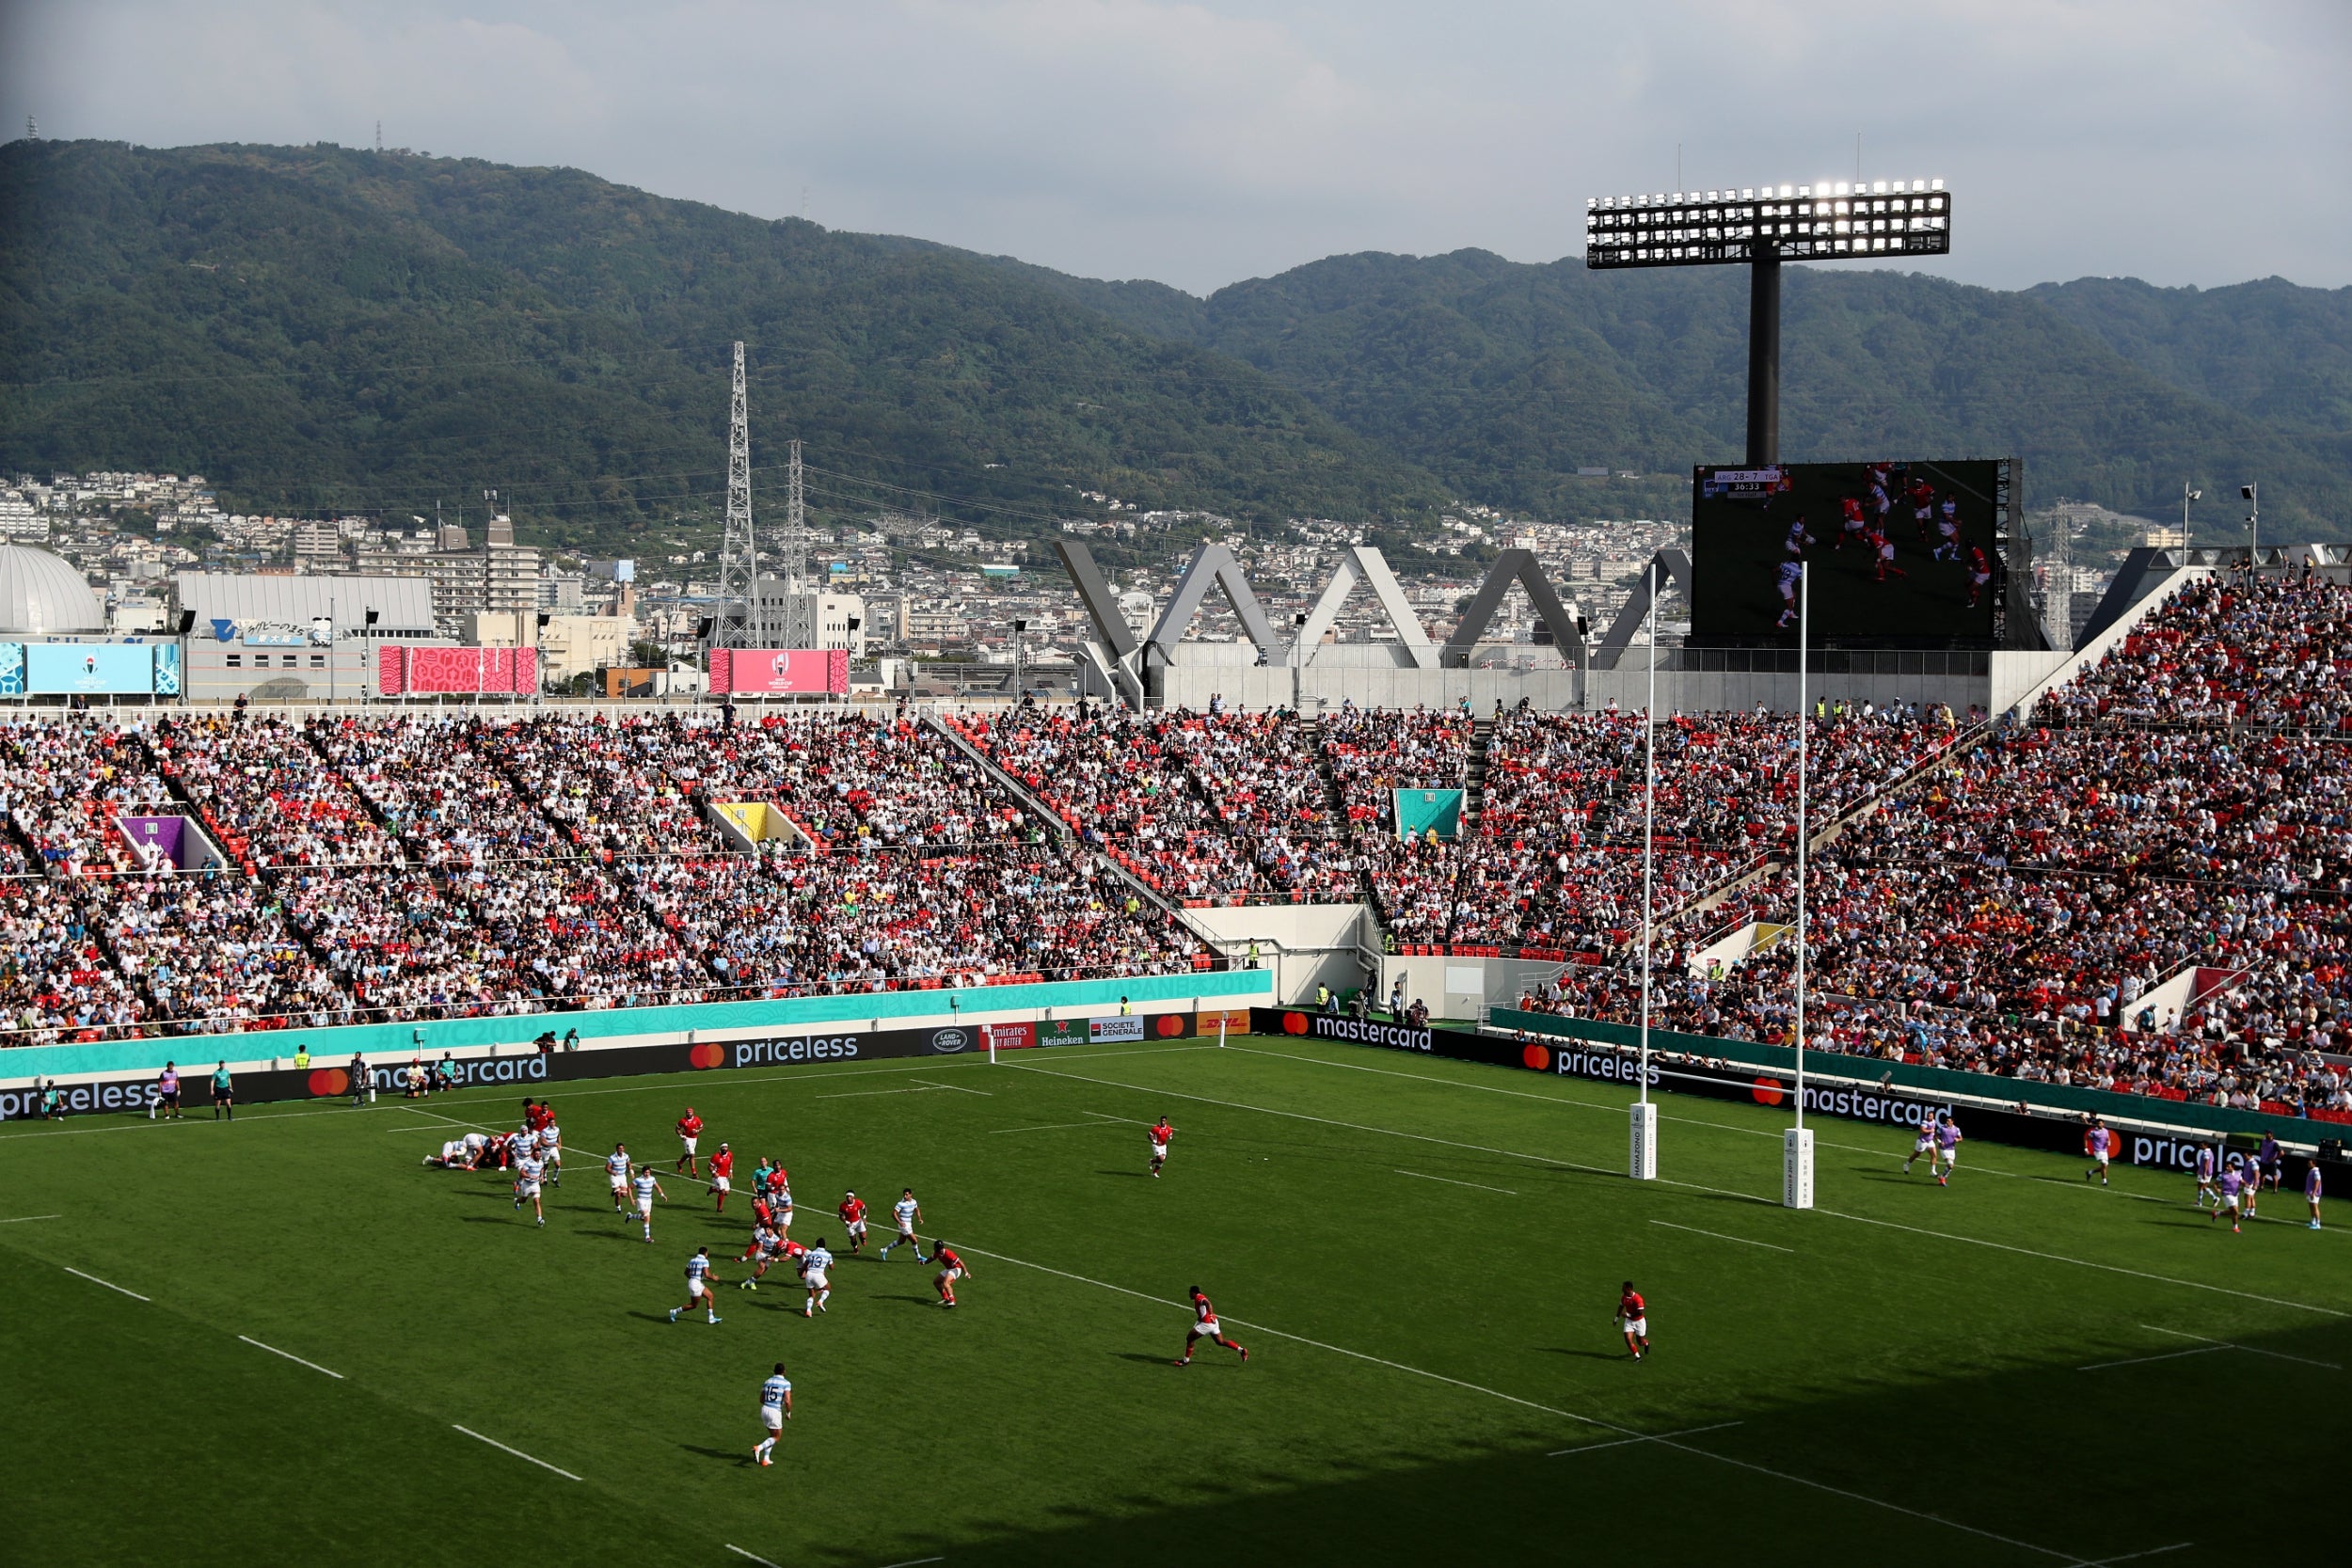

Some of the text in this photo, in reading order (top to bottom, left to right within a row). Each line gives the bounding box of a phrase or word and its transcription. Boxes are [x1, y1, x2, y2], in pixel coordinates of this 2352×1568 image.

[1734, 483, 1760, 491] 36:33
[993, 1026, 1027, 1037] mirates
[1102, 1028, 1143, 1037] GENERALE
[1316, 1017, 1432, 1051] mastercard
[1003, 1037, 1023, 1047] BETTER
[1041, 1036, 1083, 1046] Heineken
[736, 1036, 858, 1068] priceless
[1558, 1051, 1660, 1085] priceless
[1794, 1086, 1952, 1129] mastercard
[809, 1256, 823, 1269] 13
[766, 1386, 779, 1402] 15
